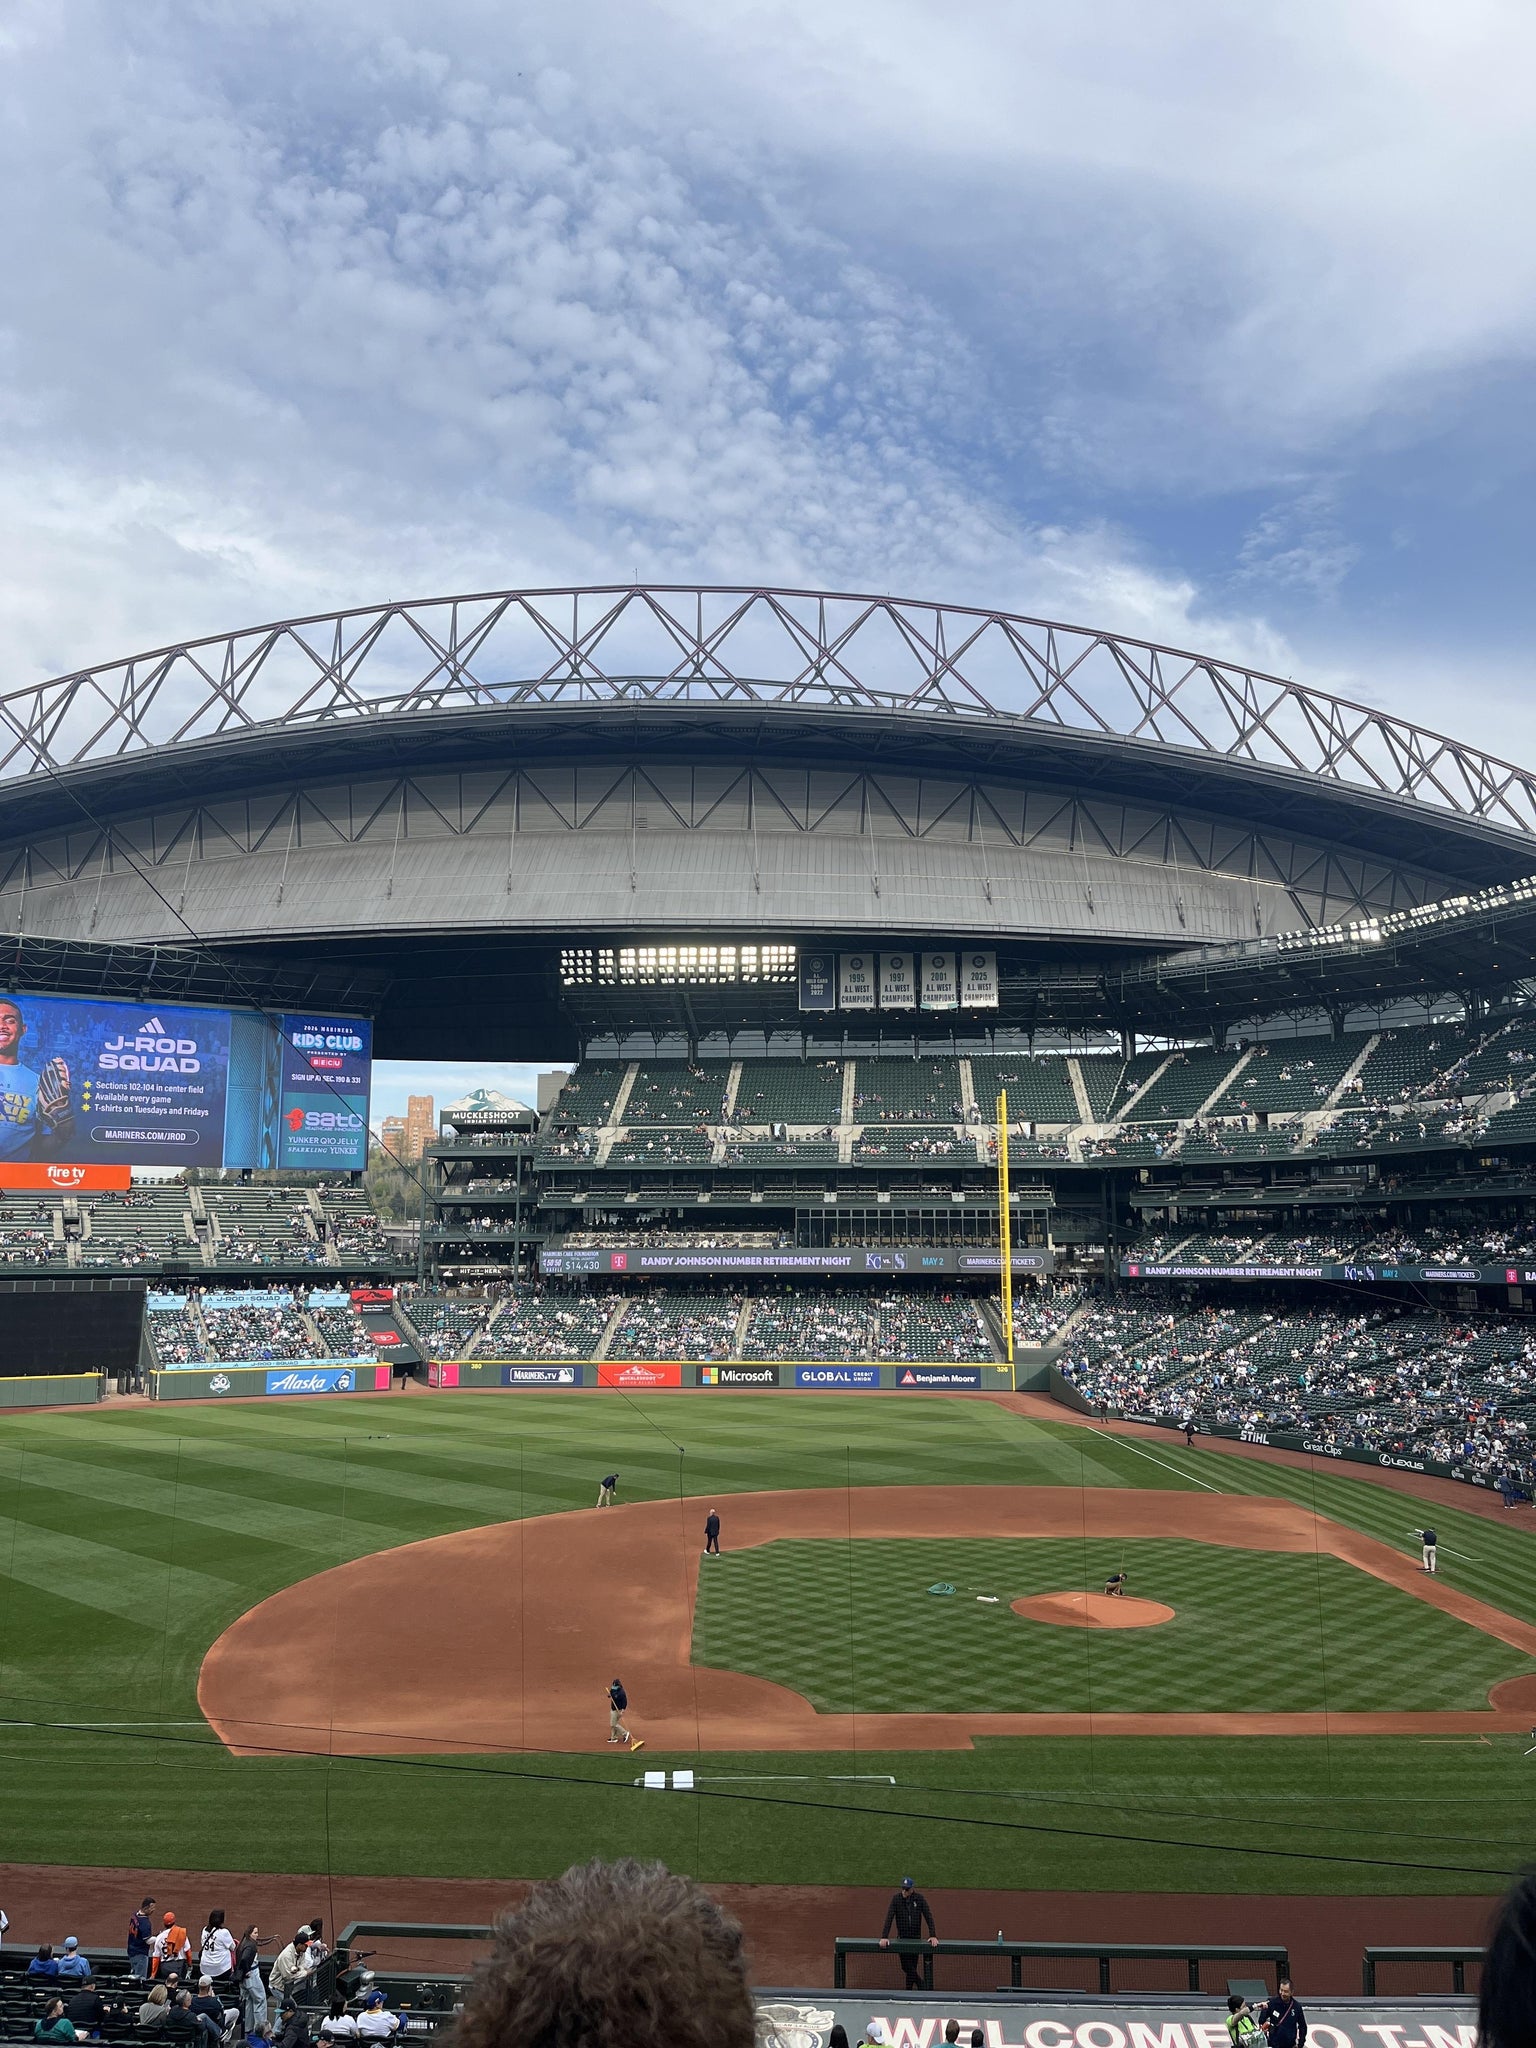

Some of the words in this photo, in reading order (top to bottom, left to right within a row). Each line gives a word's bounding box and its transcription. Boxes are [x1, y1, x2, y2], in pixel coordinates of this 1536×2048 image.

[849, 974, 864, 982] 1995
[889, 973, 904, 982] 1997
[931, 972, 947, 981] 2001
[971, 972, 987, 980] 2025
[923, 994, 955, 1002] CHAMPIONS
[105, 1036, 196, 1054] J-ROD
[292, 1032, 325, 1049] KIDS
[326, 1035, 363, 1051] CLUB
[98, 1054, 200, 1073] SQUAD
[96, 1081, 128, 1090] Sections
[129, 1083, 154, 1091] 102-104
[188, 1086, 204, 1094] field
[95, 1093, 128, 1102] Available
[130, 1096, 150, 1104] every
[95, 1104, 122, 1112] T-shirts
[135, 1105, 167, 1115] Tuesdays
[184, 1108, 209, 1117] Fridays
[305, 1112, 363, 1127] sato
[105, 1130, 186, 1141] MARINERS.COM/JROD
[47, 1166, 70, 1178] fire
[72, 1167, 85, 1178] tv
[566, 1261, 600, 1270] $14,430
[641, 1257, 673, 1266] RANDY
[674, 1257, 722, 1266] JOHNSON
[722, 1257, 762, 1266] NUMBER
[763, 1257, 820, 1266] RETIREMENT
[822, 1257, 851, 1266] NIGHT
[922, 1258, 938, 1266] MAY
[939, 1258, 944, 1266] 2
[721, 1370, 773, 1381] Microsoft
[802, 1371, 851, 1382] GLOBAL
[916, 1375, 950, 1384] Benjamin
[271, 1374, 326, 1390] Alaska
[1240, 1430, 1269, 1445] STIHL
[1303, 1441, 1324, 1453] Great
[1324, 1444, 1342, 1456] Clips
[1391, 1458, 1424, 1470] LEXUS
